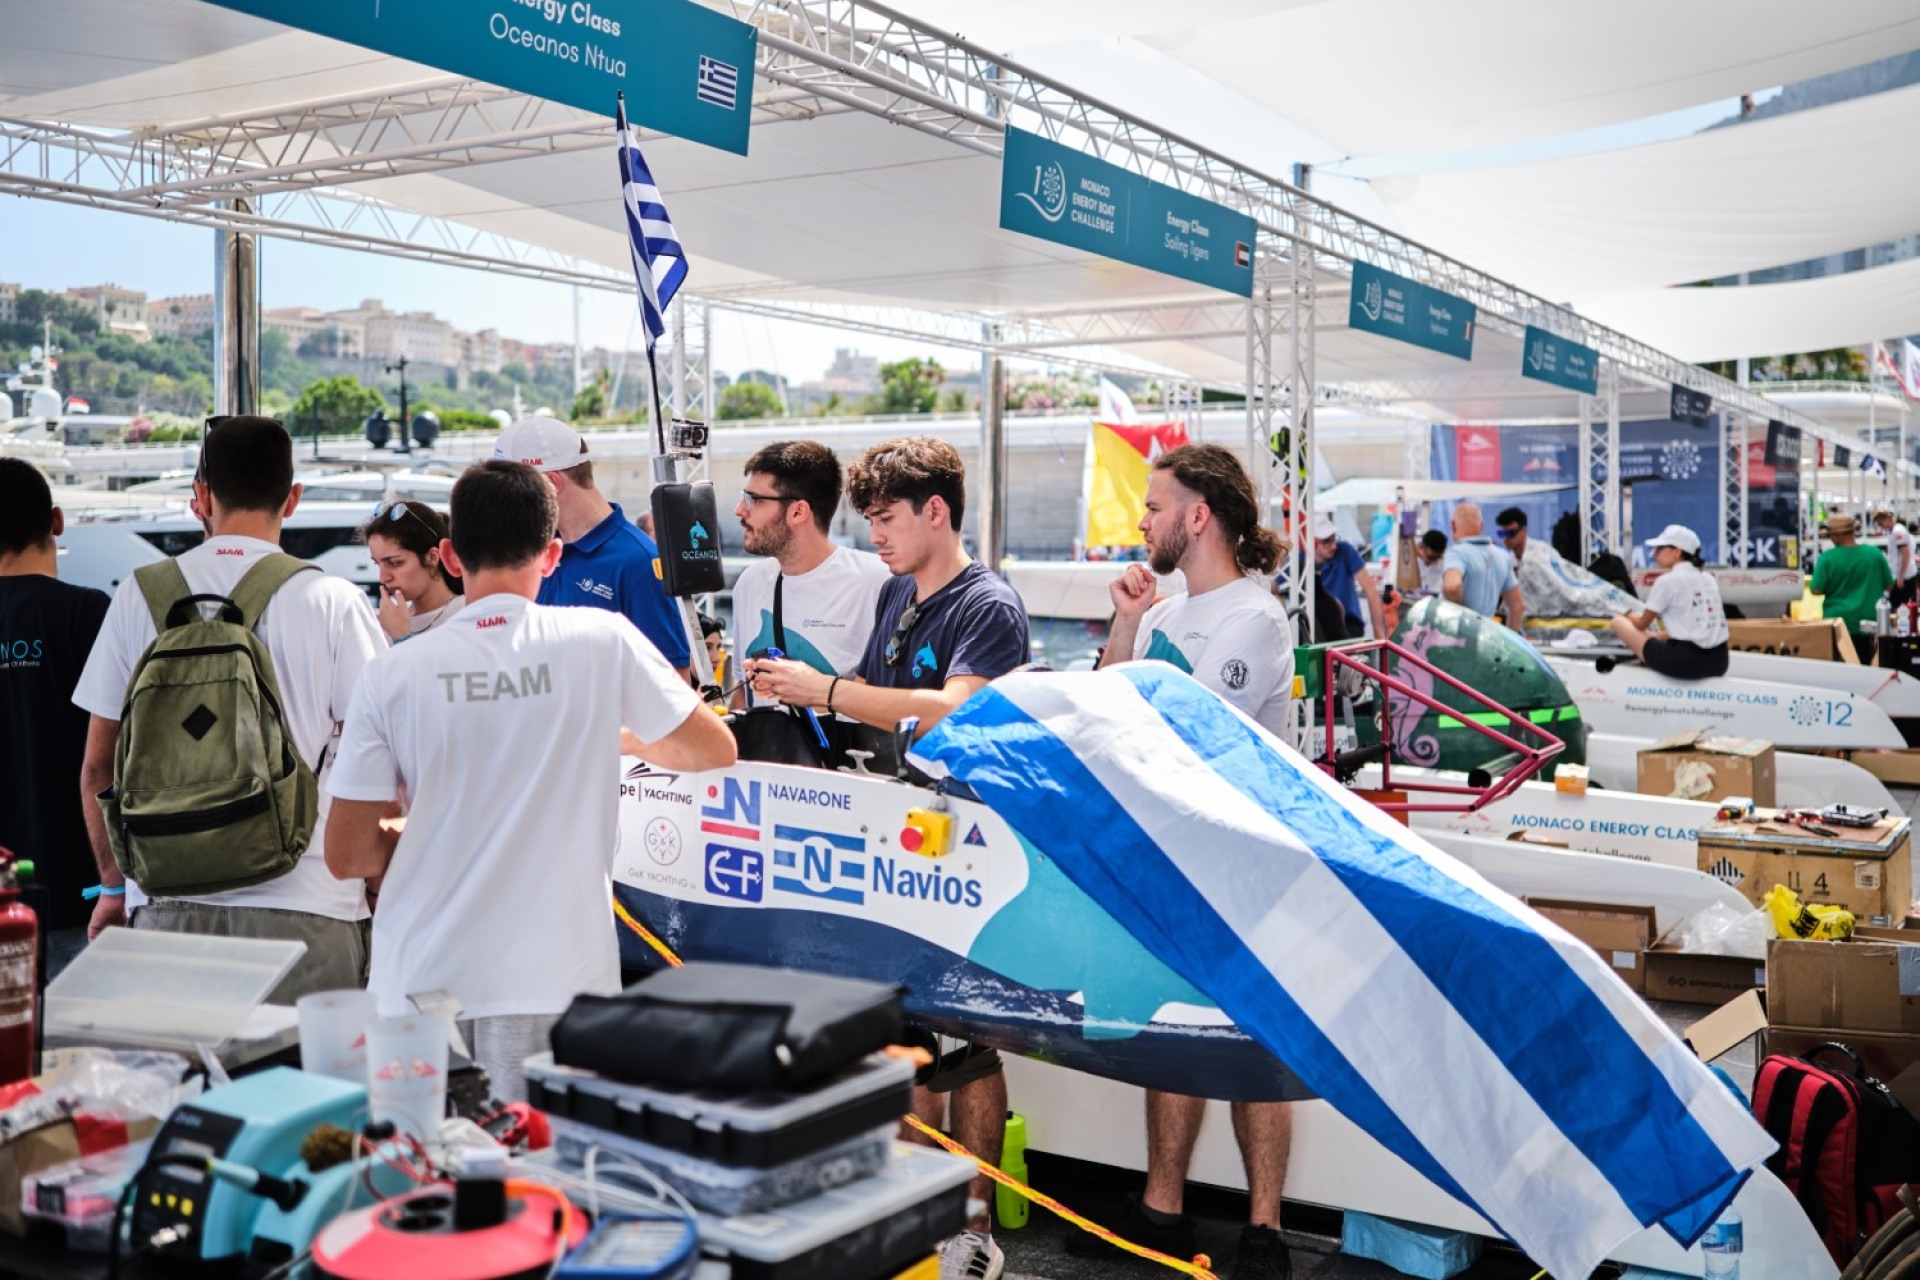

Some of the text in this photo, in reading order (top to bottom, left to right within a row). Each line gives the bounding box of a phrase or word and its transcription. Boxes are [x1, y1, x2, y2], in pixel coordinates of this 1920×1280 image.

[571, 1, 621, 37] Class
[489, 12, 627, 78] Oceanos Ntua
[1080, 178, 1111, 198] MONACO
[1072, 192, 1098, 211] ENERGY
[1071, 209, 1115, 234] CHALLENGE
[1167, 211, 1190, 234] Energy
[681, 549, 719, 560] OCEANOS
[474, 615, 508, 630] SLAM
[436, 662, 553, 703] TEAM
[1626, 686, 1779, 706] MONACO ENERGY CLASS
[1825, 700, 1853, 727] 12
[644, 787, 693, 805] YACHTING
[767, 782, 852, 810] NAVARONE
[1510, 813, 1585, 831] MONACO
[1590, 820, 1650, 837] ENERGY
[1654, 826, 1699, 842] CLAS
[647, 870, 689, 888] YACHTING
[873, 856, 983, 908] Navios
